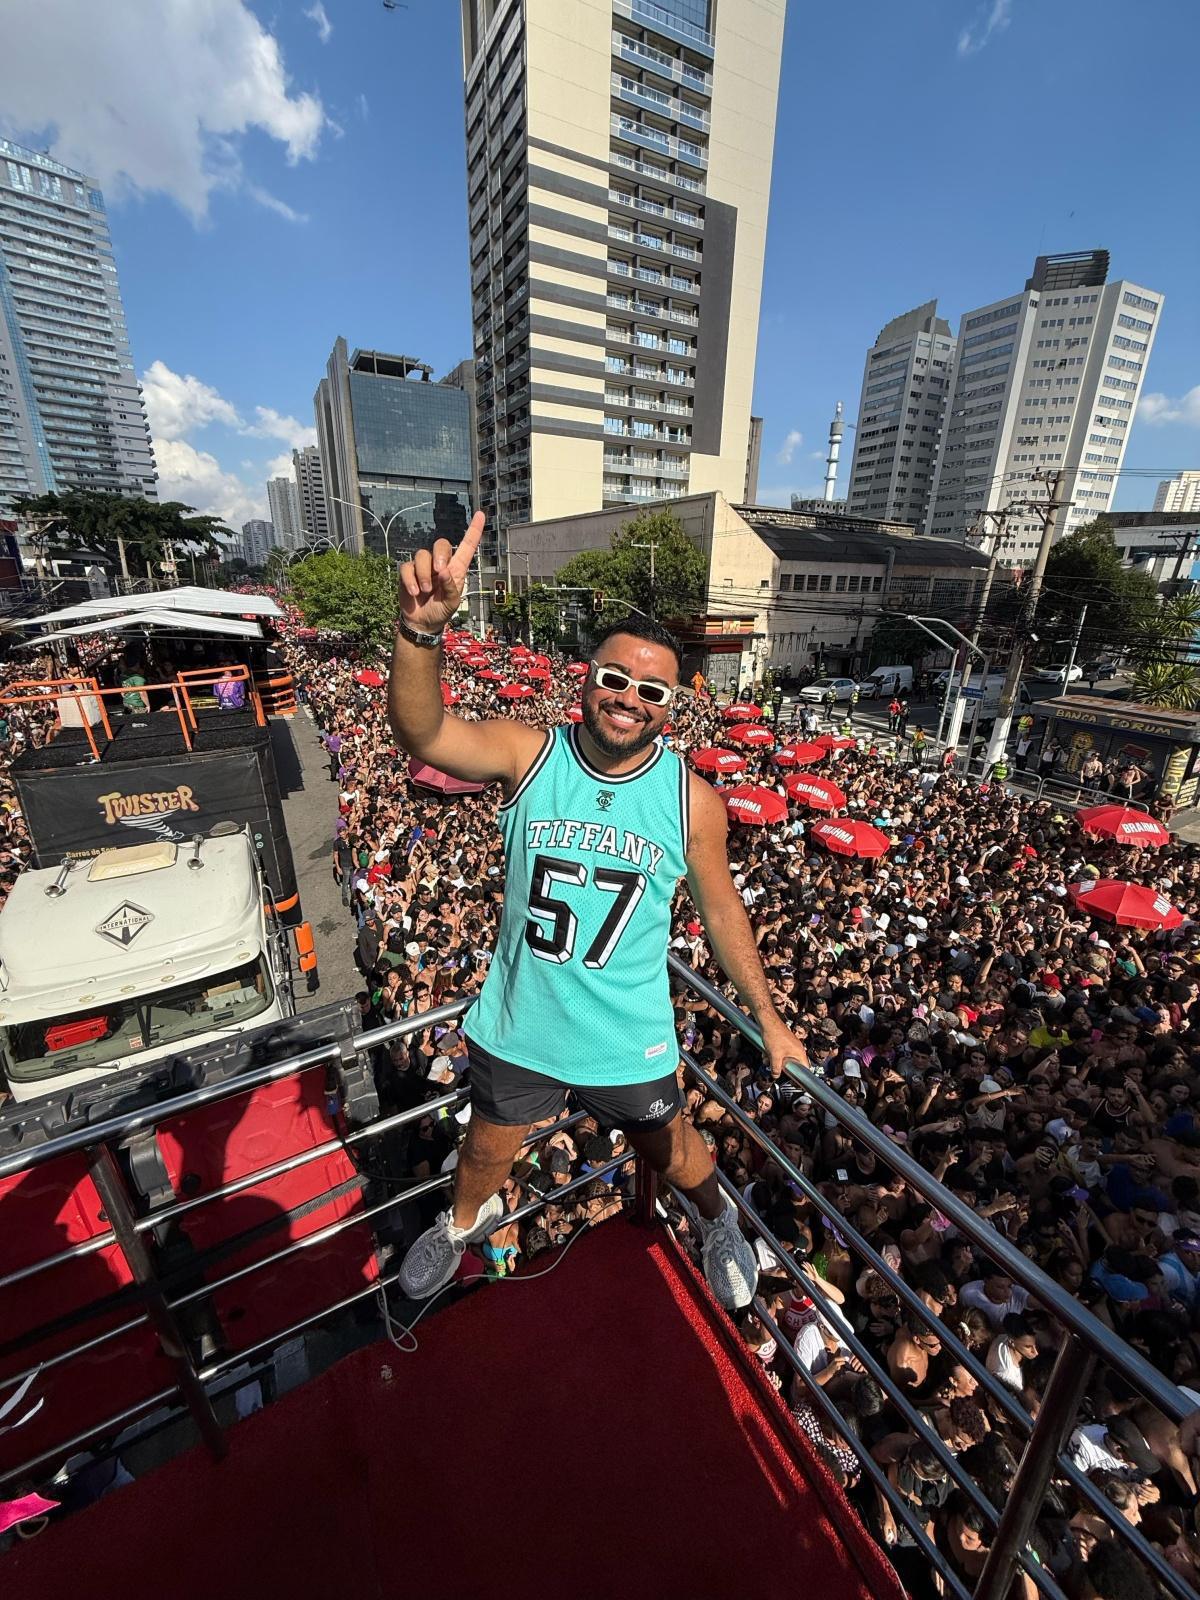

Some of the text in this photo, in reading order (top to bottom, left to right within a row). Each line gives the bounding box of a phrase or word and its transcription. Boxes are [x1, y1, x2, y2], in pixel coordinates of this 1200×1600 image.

[1056, 709, 1171, 736] BANCA FORUM
[796, 783, 829, 801] BRAHMA
[96, 784, 201, 826] TWISTER
[727, 797, 762, 815] BRAHMA
[819, 824, 855, 845] BRAHMA
[1121, 821, 1162, 835] BRAHMA
[527, 819, 665, 877] TIFFANY
[525, 853, 648, 970] 57
[100, 915, 150, 931] INTERNATIONAL
